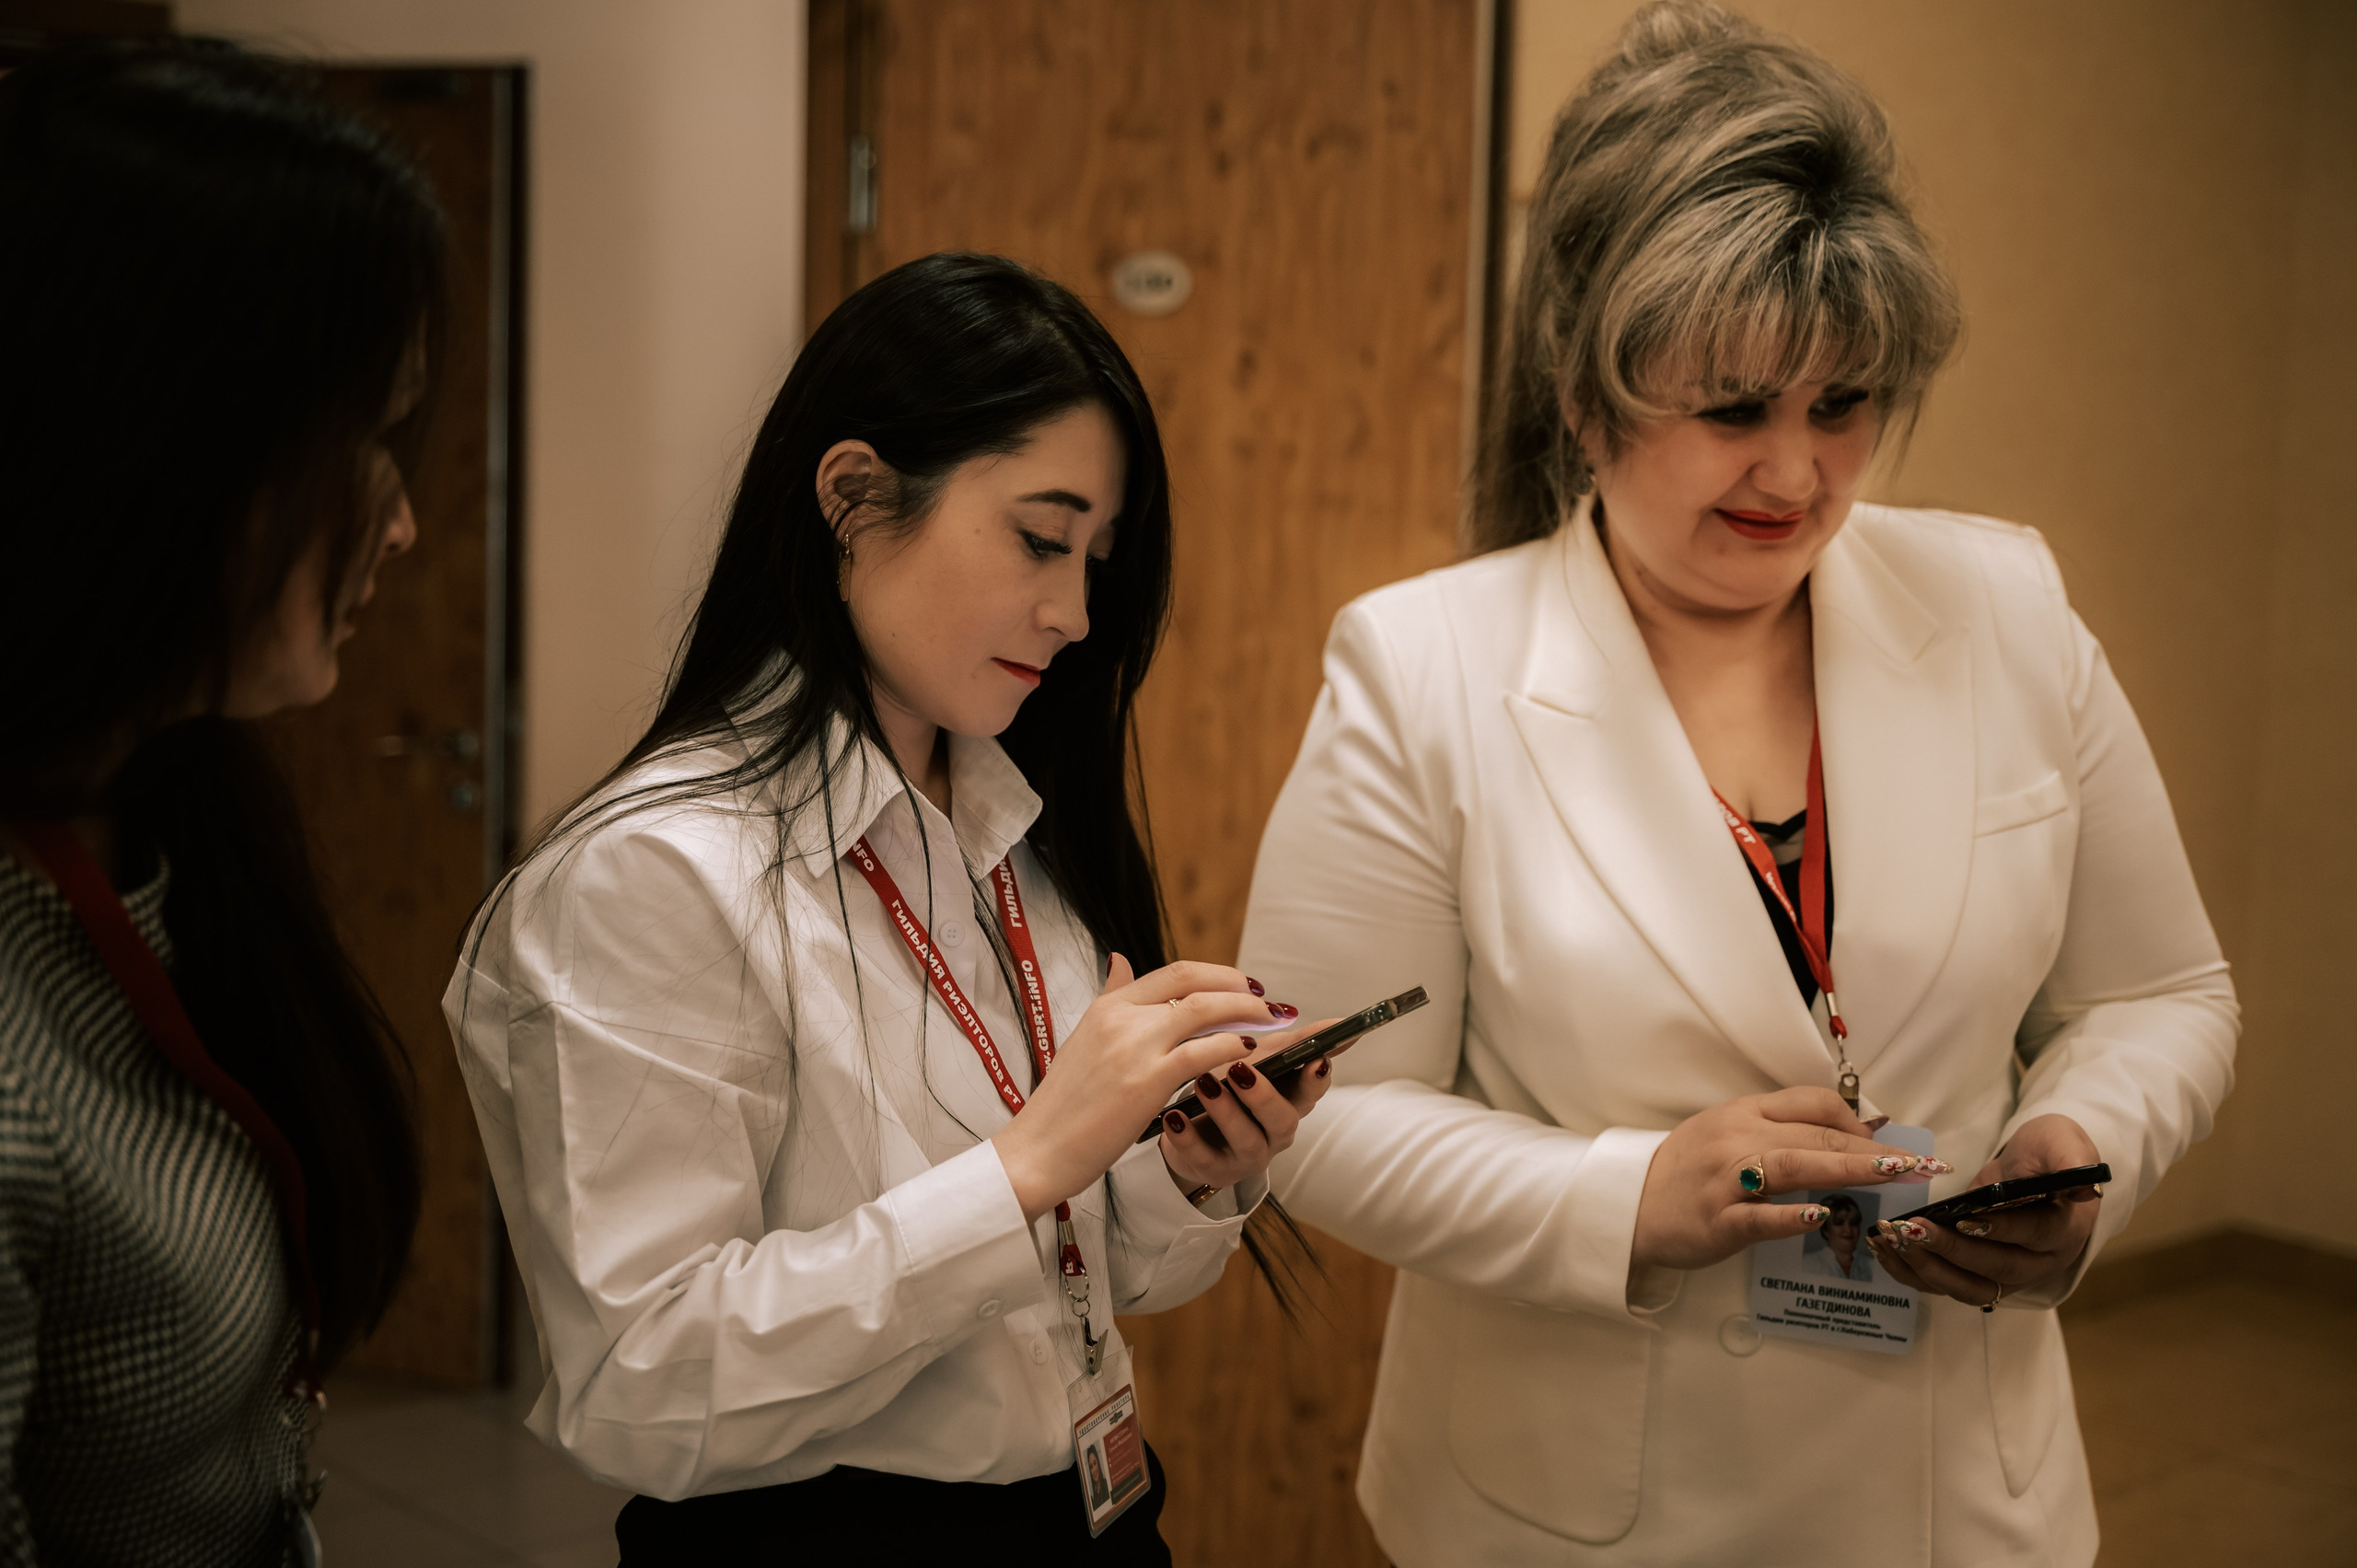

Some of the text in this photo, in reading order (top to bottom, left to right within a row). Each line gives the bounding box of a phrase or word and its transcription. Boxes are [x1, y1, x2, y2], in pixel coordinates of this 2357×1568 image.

[851, 842, 875, 872] NFO
[999, 857, 1023, 928] ГИЛЬДИ
[891, 899, 1022, 1105] ГИЛЬДИЯ РИЭЛТОРОВ РТ
[1021, 959, 1051, 1072] w.GRRT.iNFO
[1760, 1276, 1910, 1308] СВЕТЛАНА ВИНИАМИНОВНА
[1796, 1296, 1871, 1318] ГАЗЕТДИНОВА
